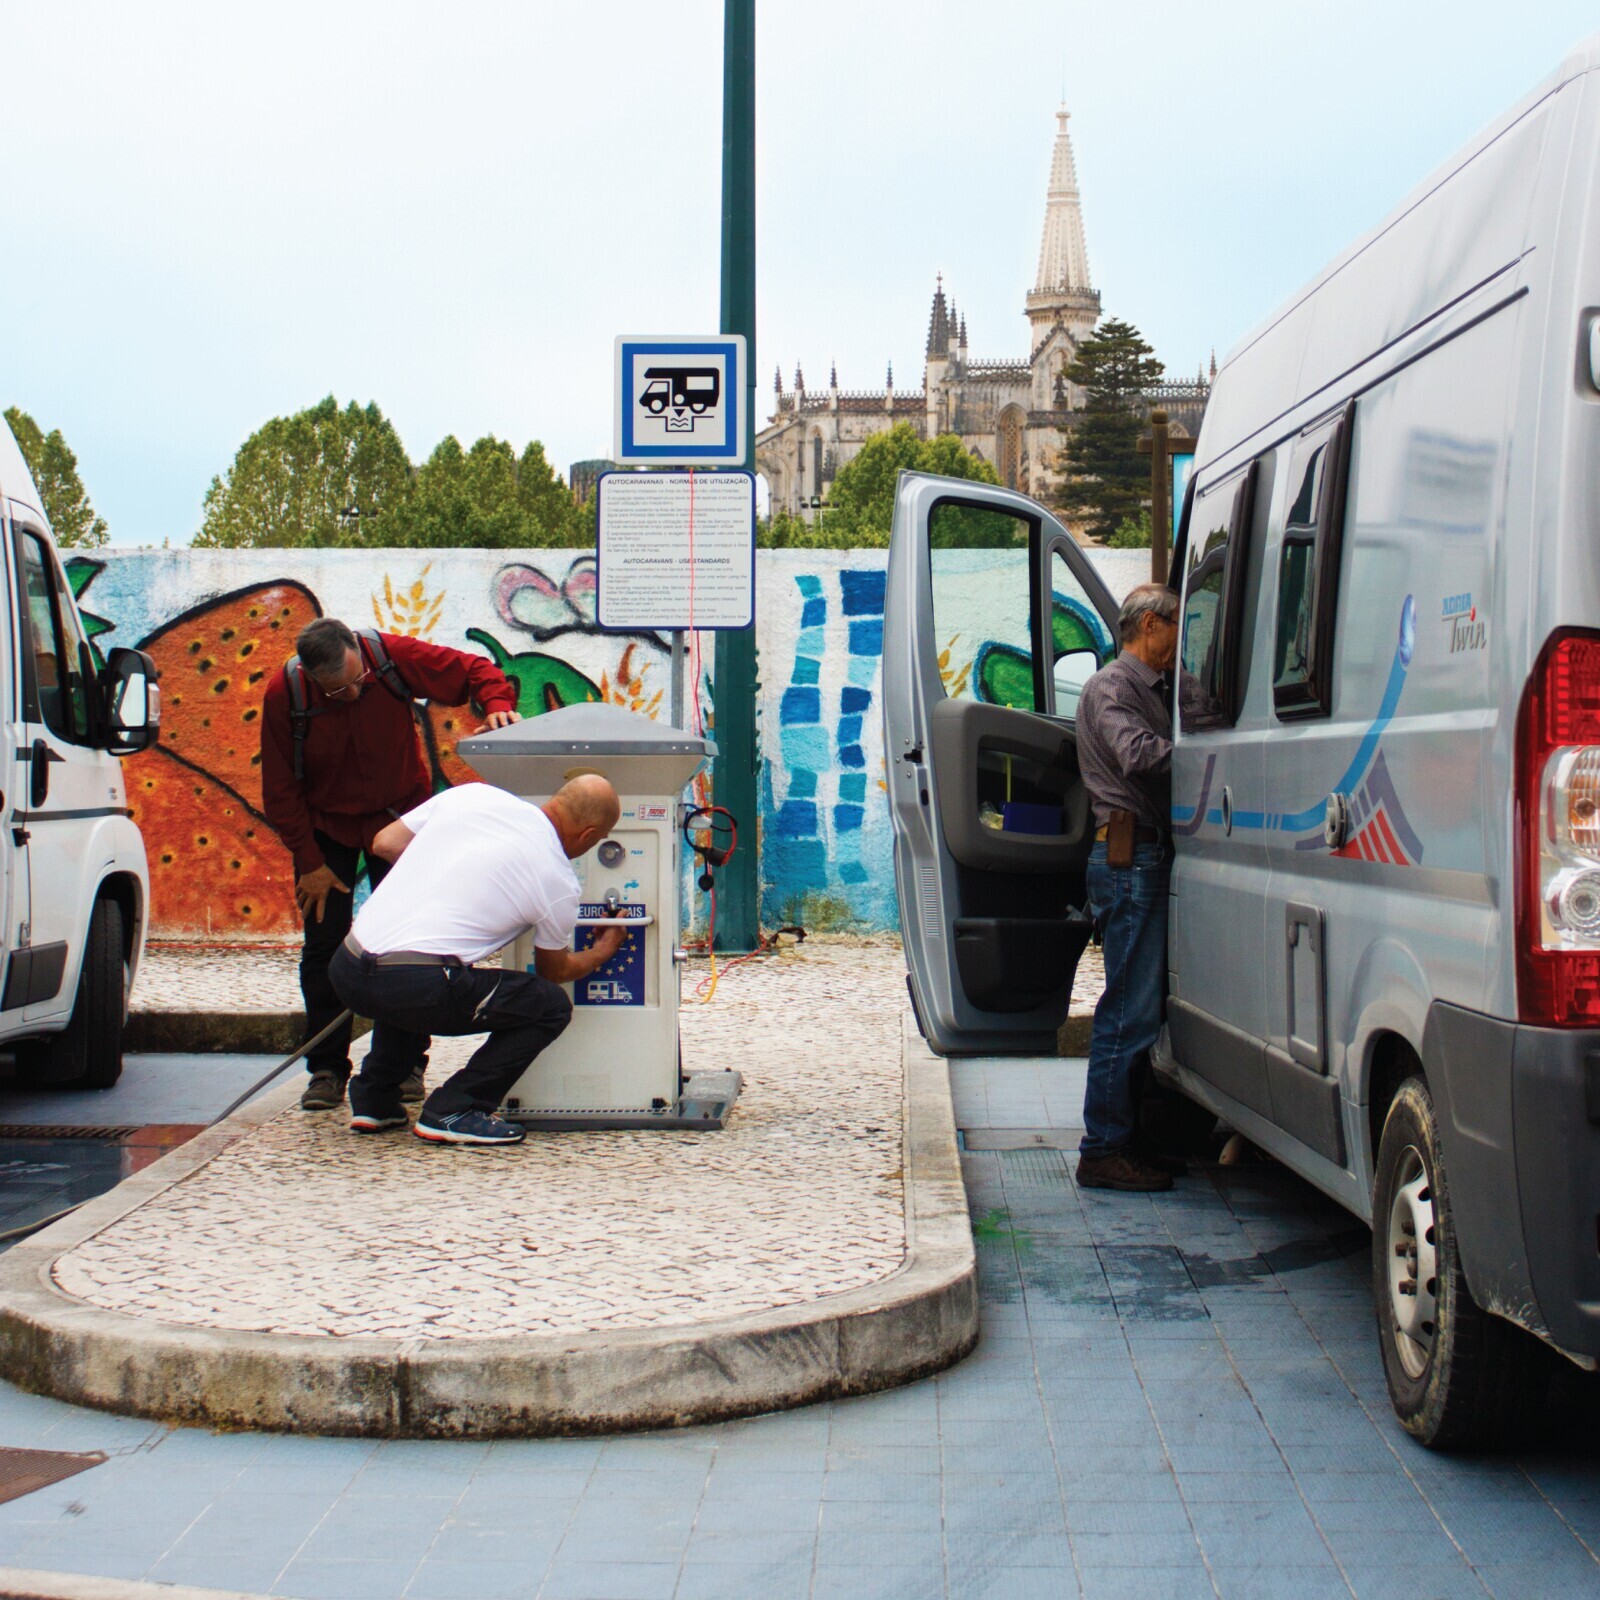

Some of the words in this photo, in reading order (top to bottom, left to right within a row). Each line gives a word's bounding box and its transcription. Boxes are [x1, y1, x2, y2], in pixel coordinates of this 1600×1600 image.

[1442, 592, 1471, 615] ADRIA
[1441, 606, 1488, 654] Twin
[578, 906, 604, 917] EURO
